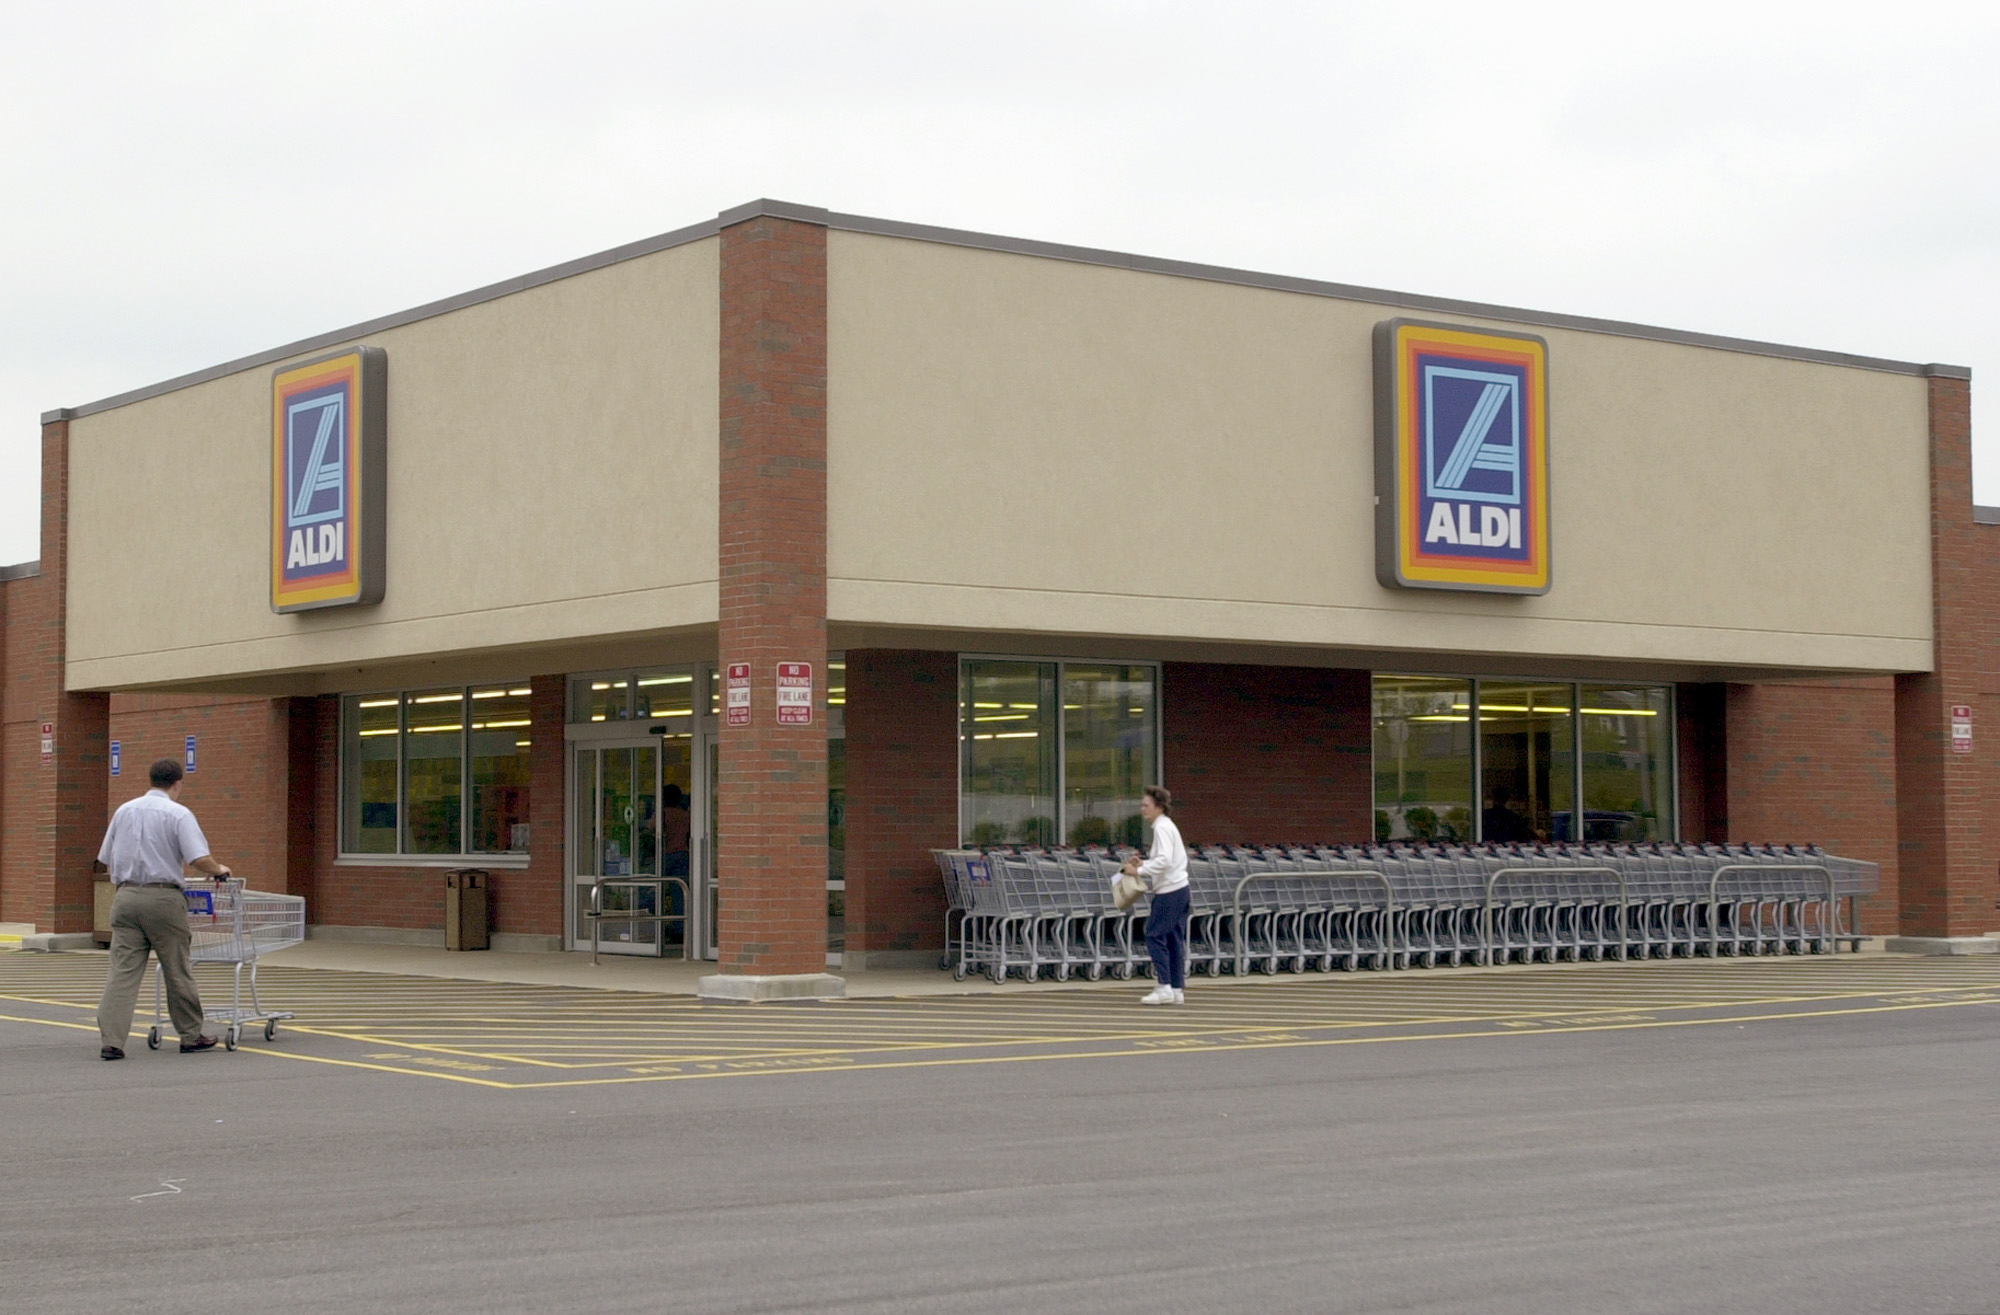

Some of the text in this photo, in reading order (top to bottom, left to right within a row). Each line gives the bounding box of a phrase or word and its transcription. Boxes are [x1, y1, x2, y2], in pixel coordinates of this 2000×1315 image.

[1425, 502, 1521, 549] ALDI
[287, 521, 344, 570] ALDI
[788, 665, 800, 675] NO
[779, 677, 809, 687] PARKING
[780, 691, 808, 701] FIRE LANE
